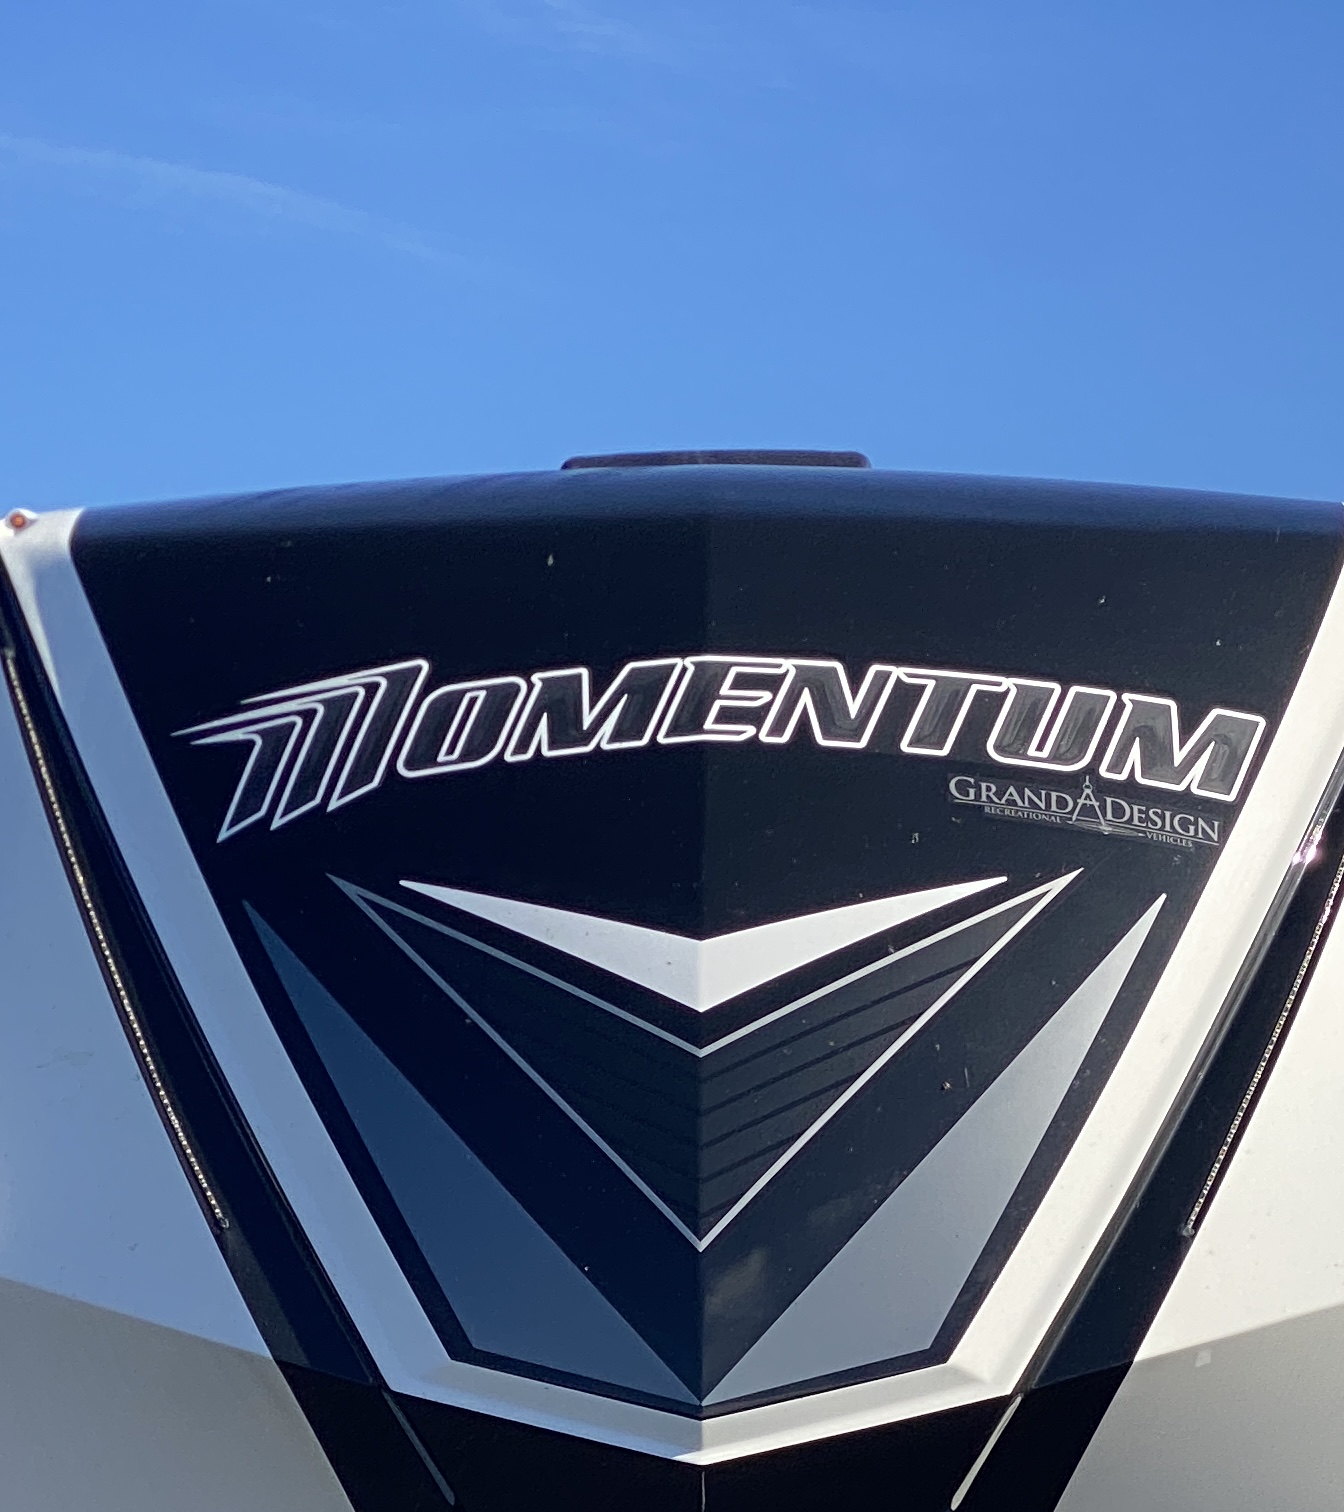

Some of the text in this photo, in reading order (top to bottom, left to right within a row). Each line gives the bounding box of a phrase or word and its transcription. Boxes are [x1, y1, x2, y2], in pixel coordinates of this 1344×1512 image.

[170, 656, 1269, 843] MOMENTUM
[948, 776, 1220, 842] GRAND DESIGN
[983, 804, 1194, 848] RECREATIONAL VEHICLES
